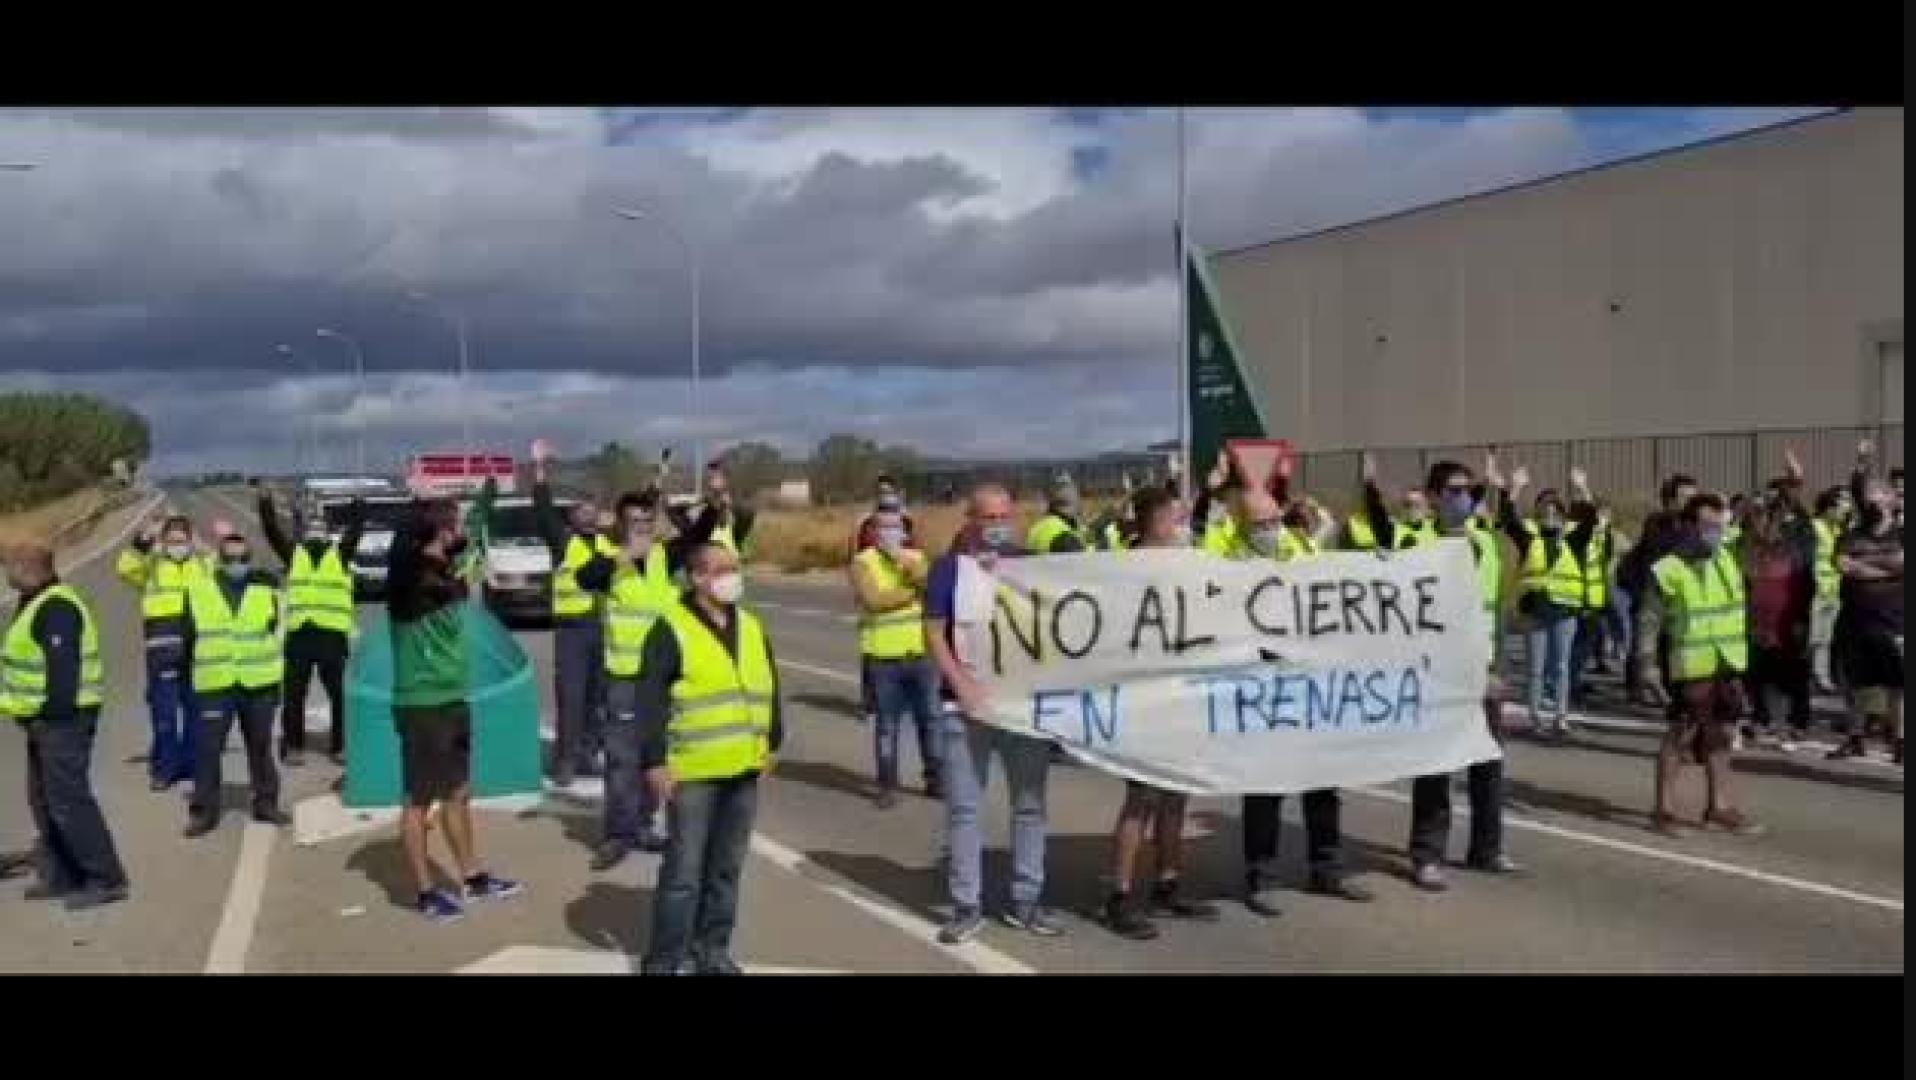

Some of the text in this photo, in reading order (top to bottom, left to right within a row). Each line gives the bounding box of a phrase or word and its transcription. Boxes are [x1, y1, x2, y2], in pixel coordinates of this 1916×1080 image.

[990, 588, 1101, 675] NO
[1245, 576, 1445, 636] CIERRE
[1032, 684, 1120, 746] EN
